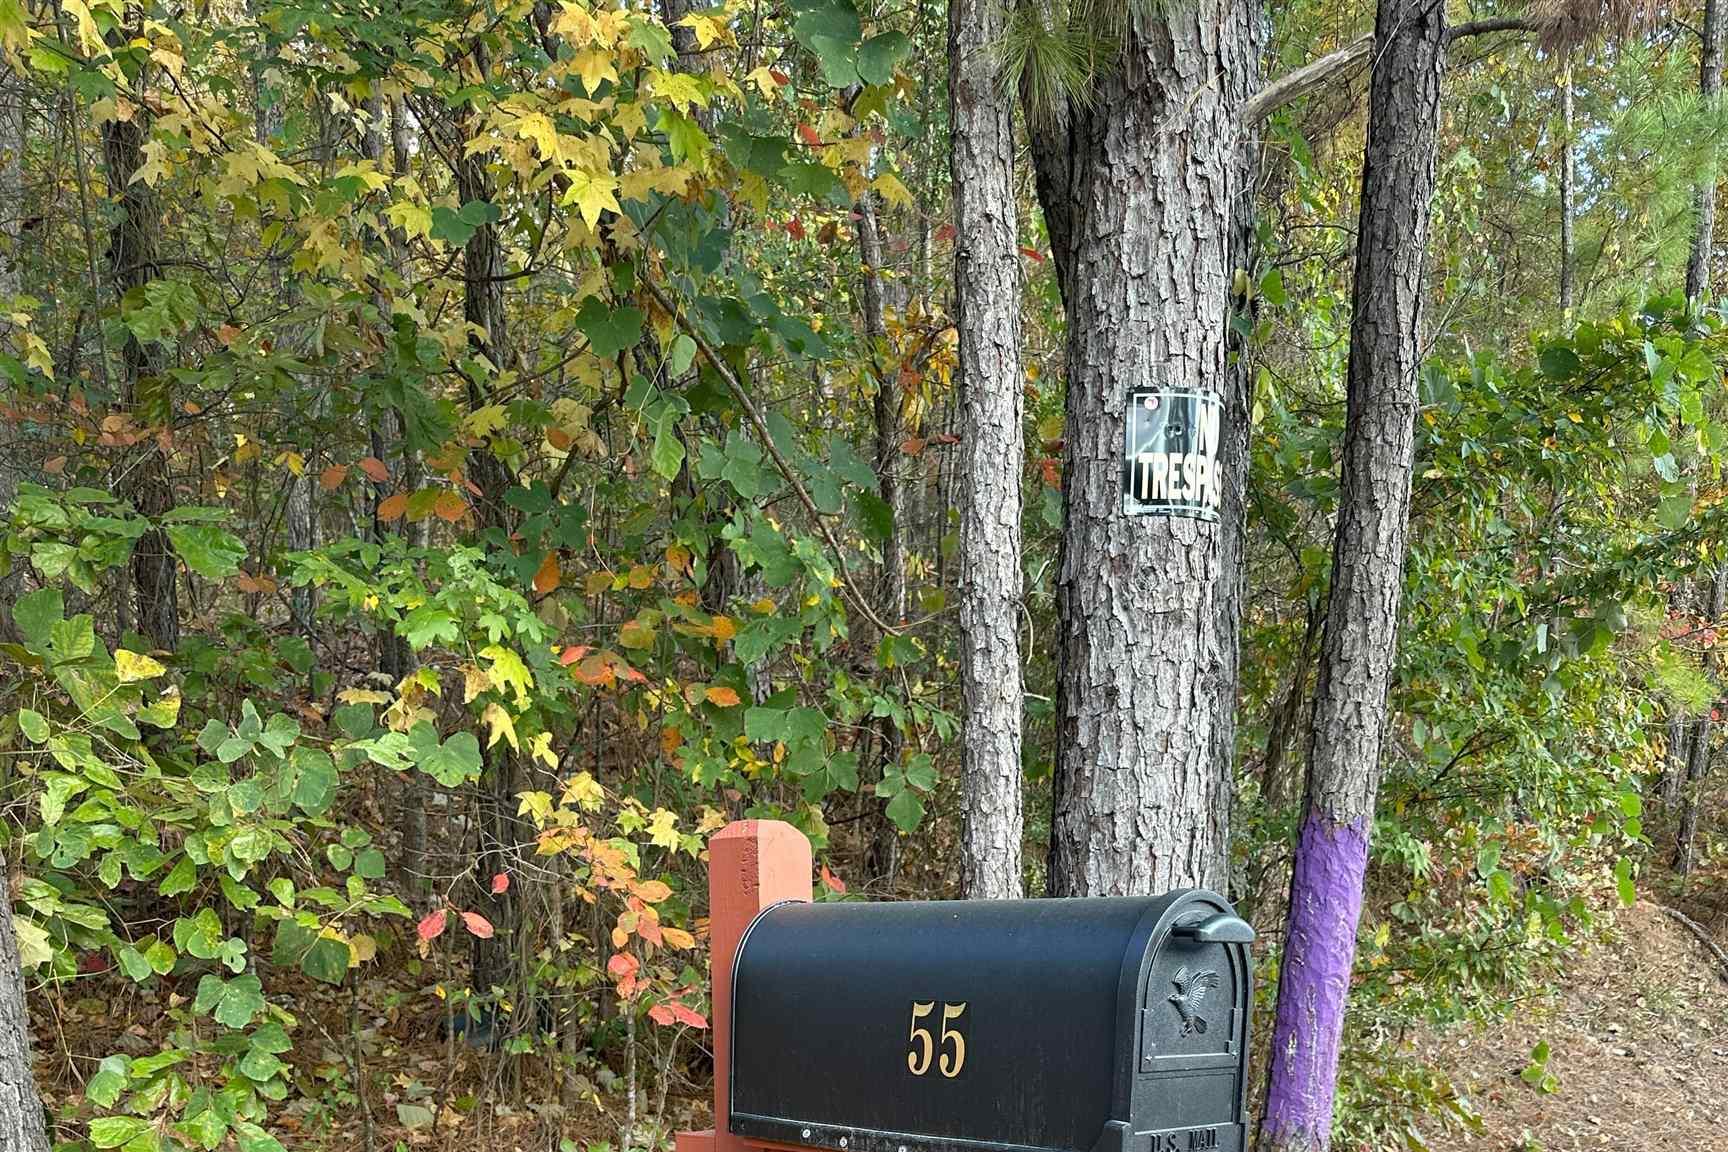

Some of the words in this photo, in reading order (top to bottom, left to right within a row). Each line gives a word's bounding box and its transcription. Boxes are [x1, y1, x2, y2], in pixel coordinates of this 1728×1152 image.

[1137, 452, 1222, 509] TRESPAS
[907, 1000, 966, 1078] 55
[1187, 1127, 1220, 1152] MAIL
